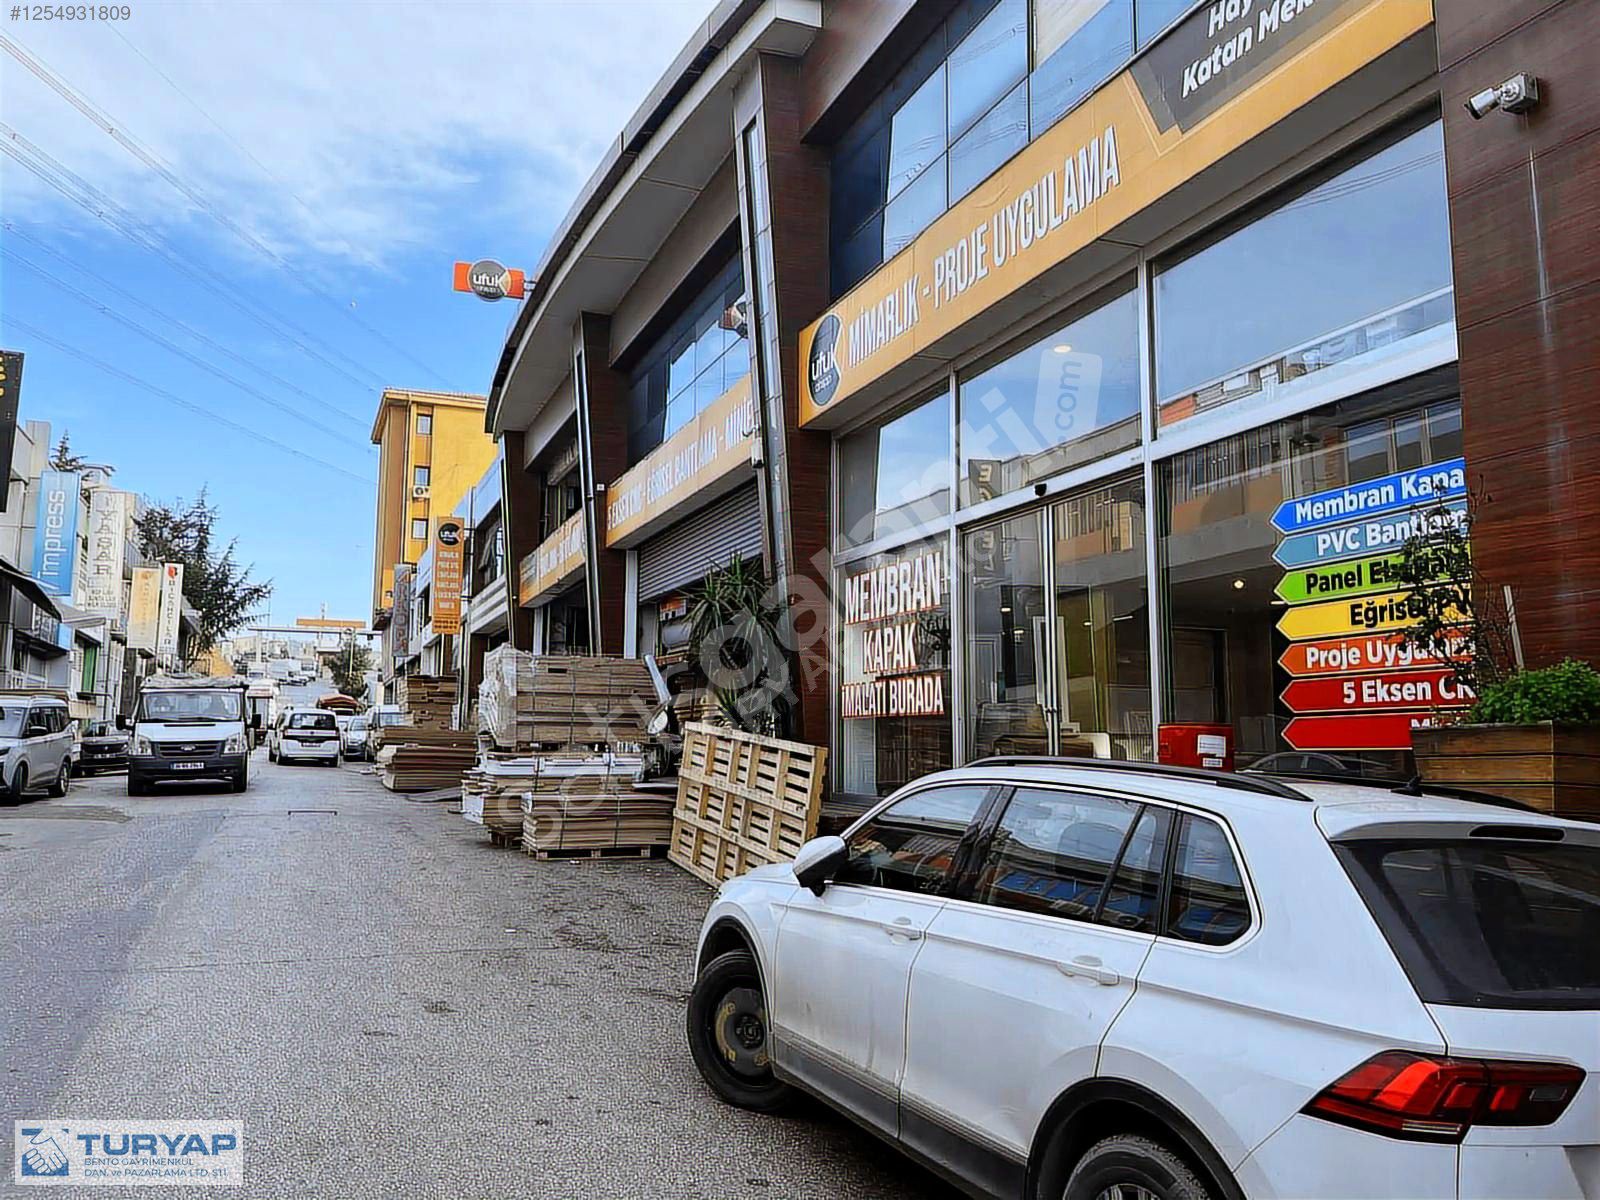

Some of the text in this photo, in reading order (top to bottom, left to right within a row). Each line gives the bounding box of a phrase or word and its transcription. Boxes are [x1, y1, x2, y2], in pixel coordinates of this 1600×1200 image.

[1181, 26, 1253, 98] Katan
[848, 272, 919, 369] MİMARLIK
[934, 221, 989, 309] PROJE
[991, 124, 1120, 268] UYGULAMA
[472, 273, 501, 288] ufuk
[1295, 483, 1395, 524] Membran
[1317, 527, 1360, 556] PVC
[845, 552, 941, 625] MEMBRAN
[1306, 563, 1363, 594] Panel
[864, 622, 917, 674] KAPAK
[1306, 646, 1360, 670] Proje
[842, 675, 944, 719] İMALATI BURADA
[1343, 682, 1355, 704] 5
[1362, 679, 1432, 703] Eksen
